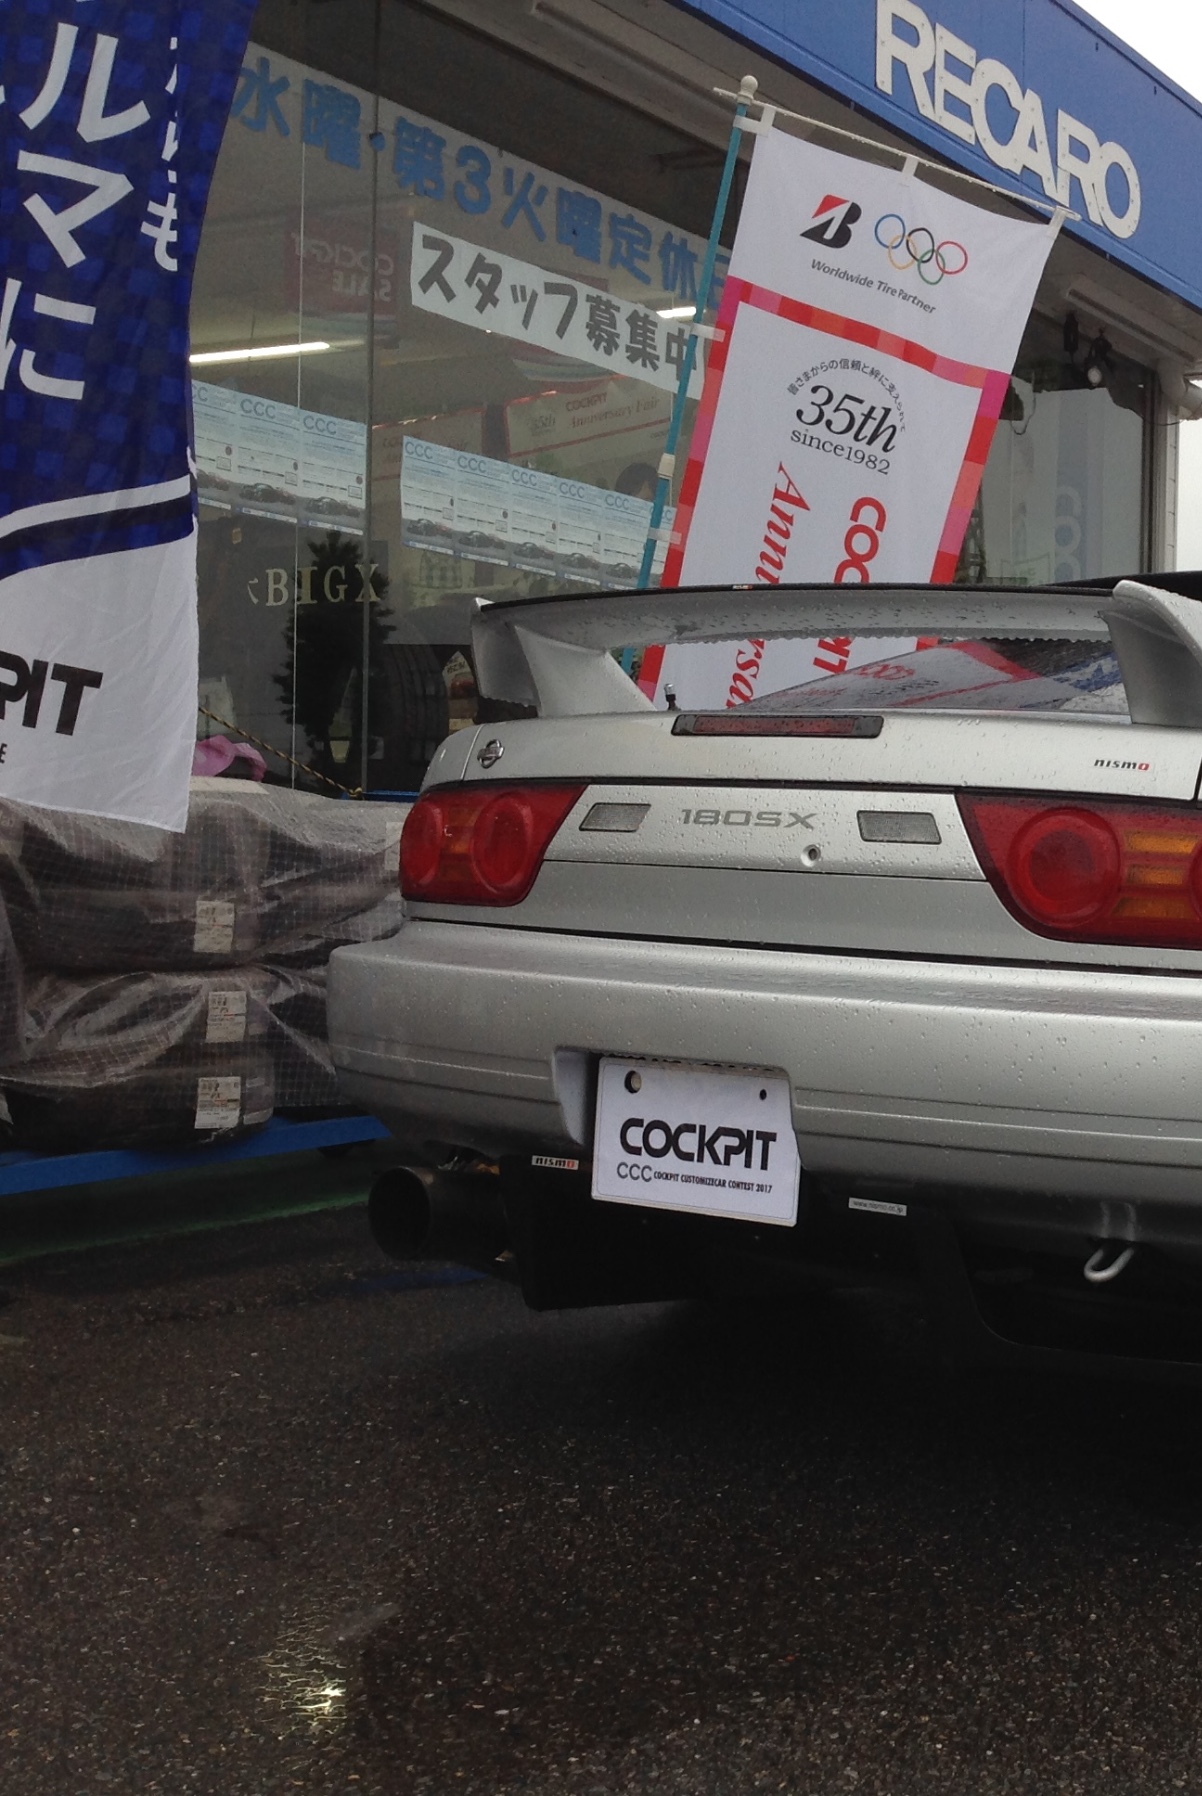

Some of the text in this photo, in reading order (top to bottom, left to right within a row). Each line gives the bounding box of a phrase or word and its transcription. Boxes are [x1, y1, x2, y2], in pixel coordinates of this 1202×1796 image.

[875, 0, 1141, 239] RECARO
[811, 258, 936, 314] Worldwide Tire Partner
[418, 233, 698, 382] スタッフ募集中
[240, 398, 277, 420] CCC
[796, 384, 898, 453] 35th
[303, 415, 337, 436] CCC
[404, 441, 434, 460] CCC
[790, 428, 891, 475] since1982
[457, 455, 487, 474] CCC
[511, 469, 538, 487] CCC
[559, 482, 586, 499] CCC
[605, 494, 630, 510] CCC
[1094, 759, 1150, 771] nismo
[681, 809, 818, 831] 180SX
[619, 1117, 778, 1171] COCKPIT
[535, 1157, 576, 1169] nismo
[617, 1162, 653, 1183] CCC
[653, 1171, 679, 1182] COCKPIT
[728, 1180, 754, 1191] CONTEST
[755, 1184, 773, 1194] 2017
